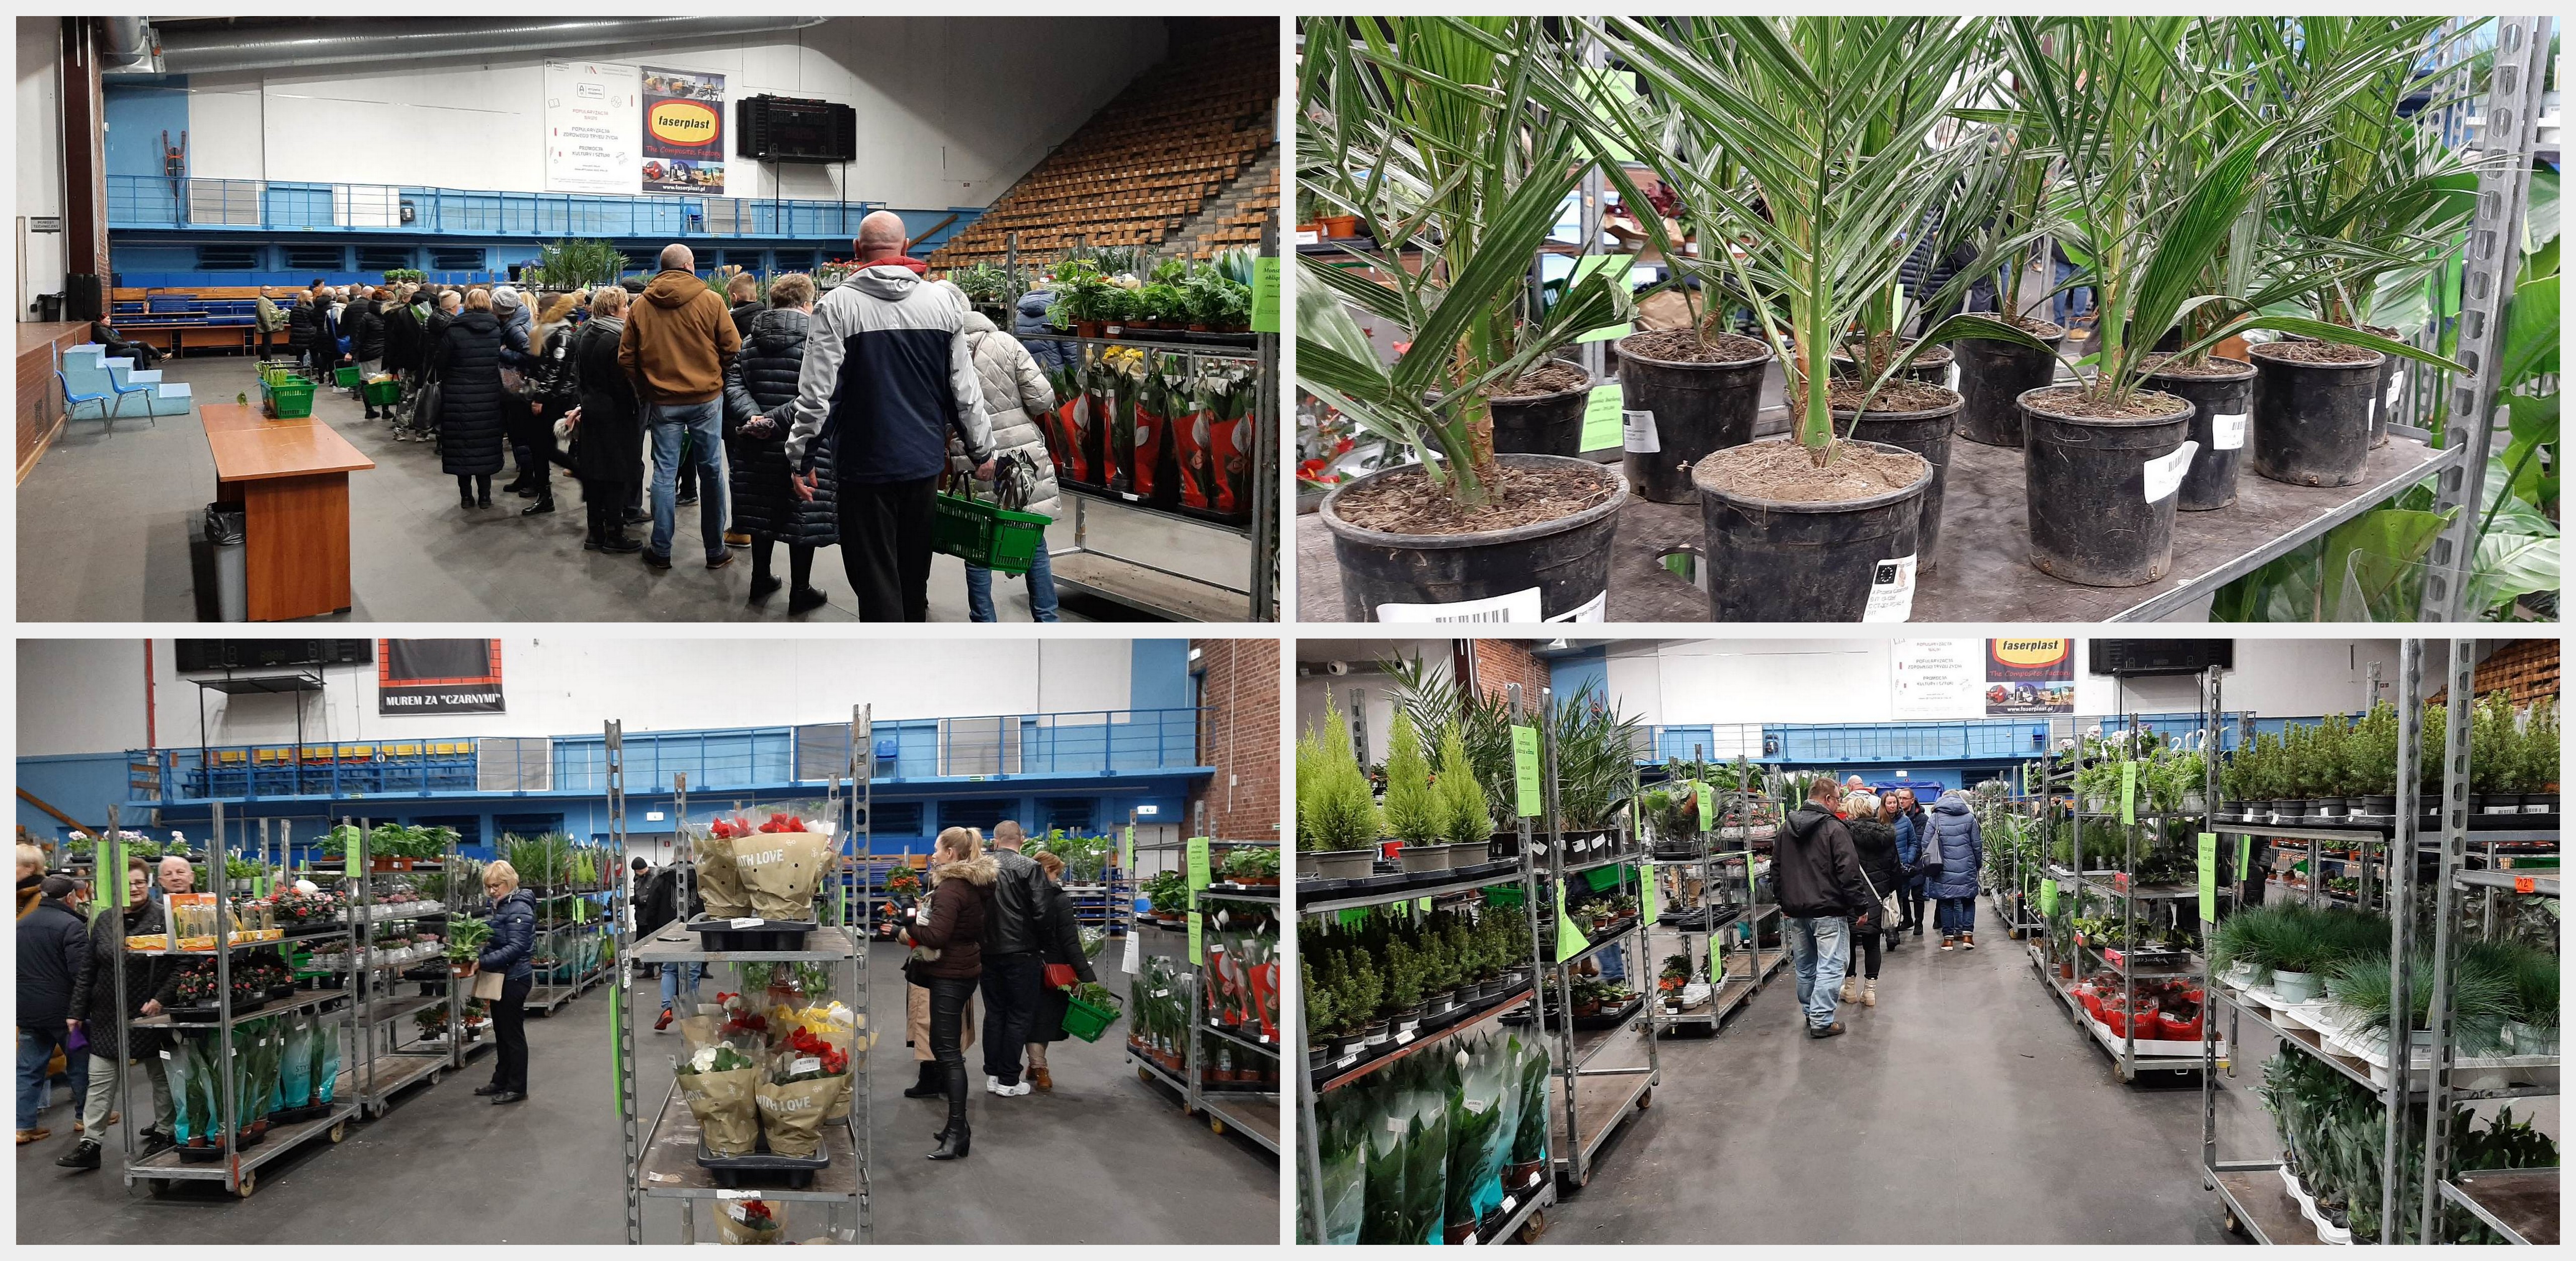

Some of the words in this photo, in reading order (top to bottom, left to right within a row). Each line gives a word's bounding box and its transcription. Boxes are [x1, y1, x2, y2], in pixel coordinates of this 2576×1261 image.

[659, 116, 709, 129] faserplast
[697, 149, 721, 159] Factory
[2003, 640, 2058, 652] faserplast
[2005, 670, 2043, 678] Composites
[2045, 670, 2071, 678] Factory
[386, 696, 422, 705] MUREM
[425, 695, 438, 704] ZA
[756, 849, 784, 864] LOVE
[781, 1096, 812, 1112] LOVE
